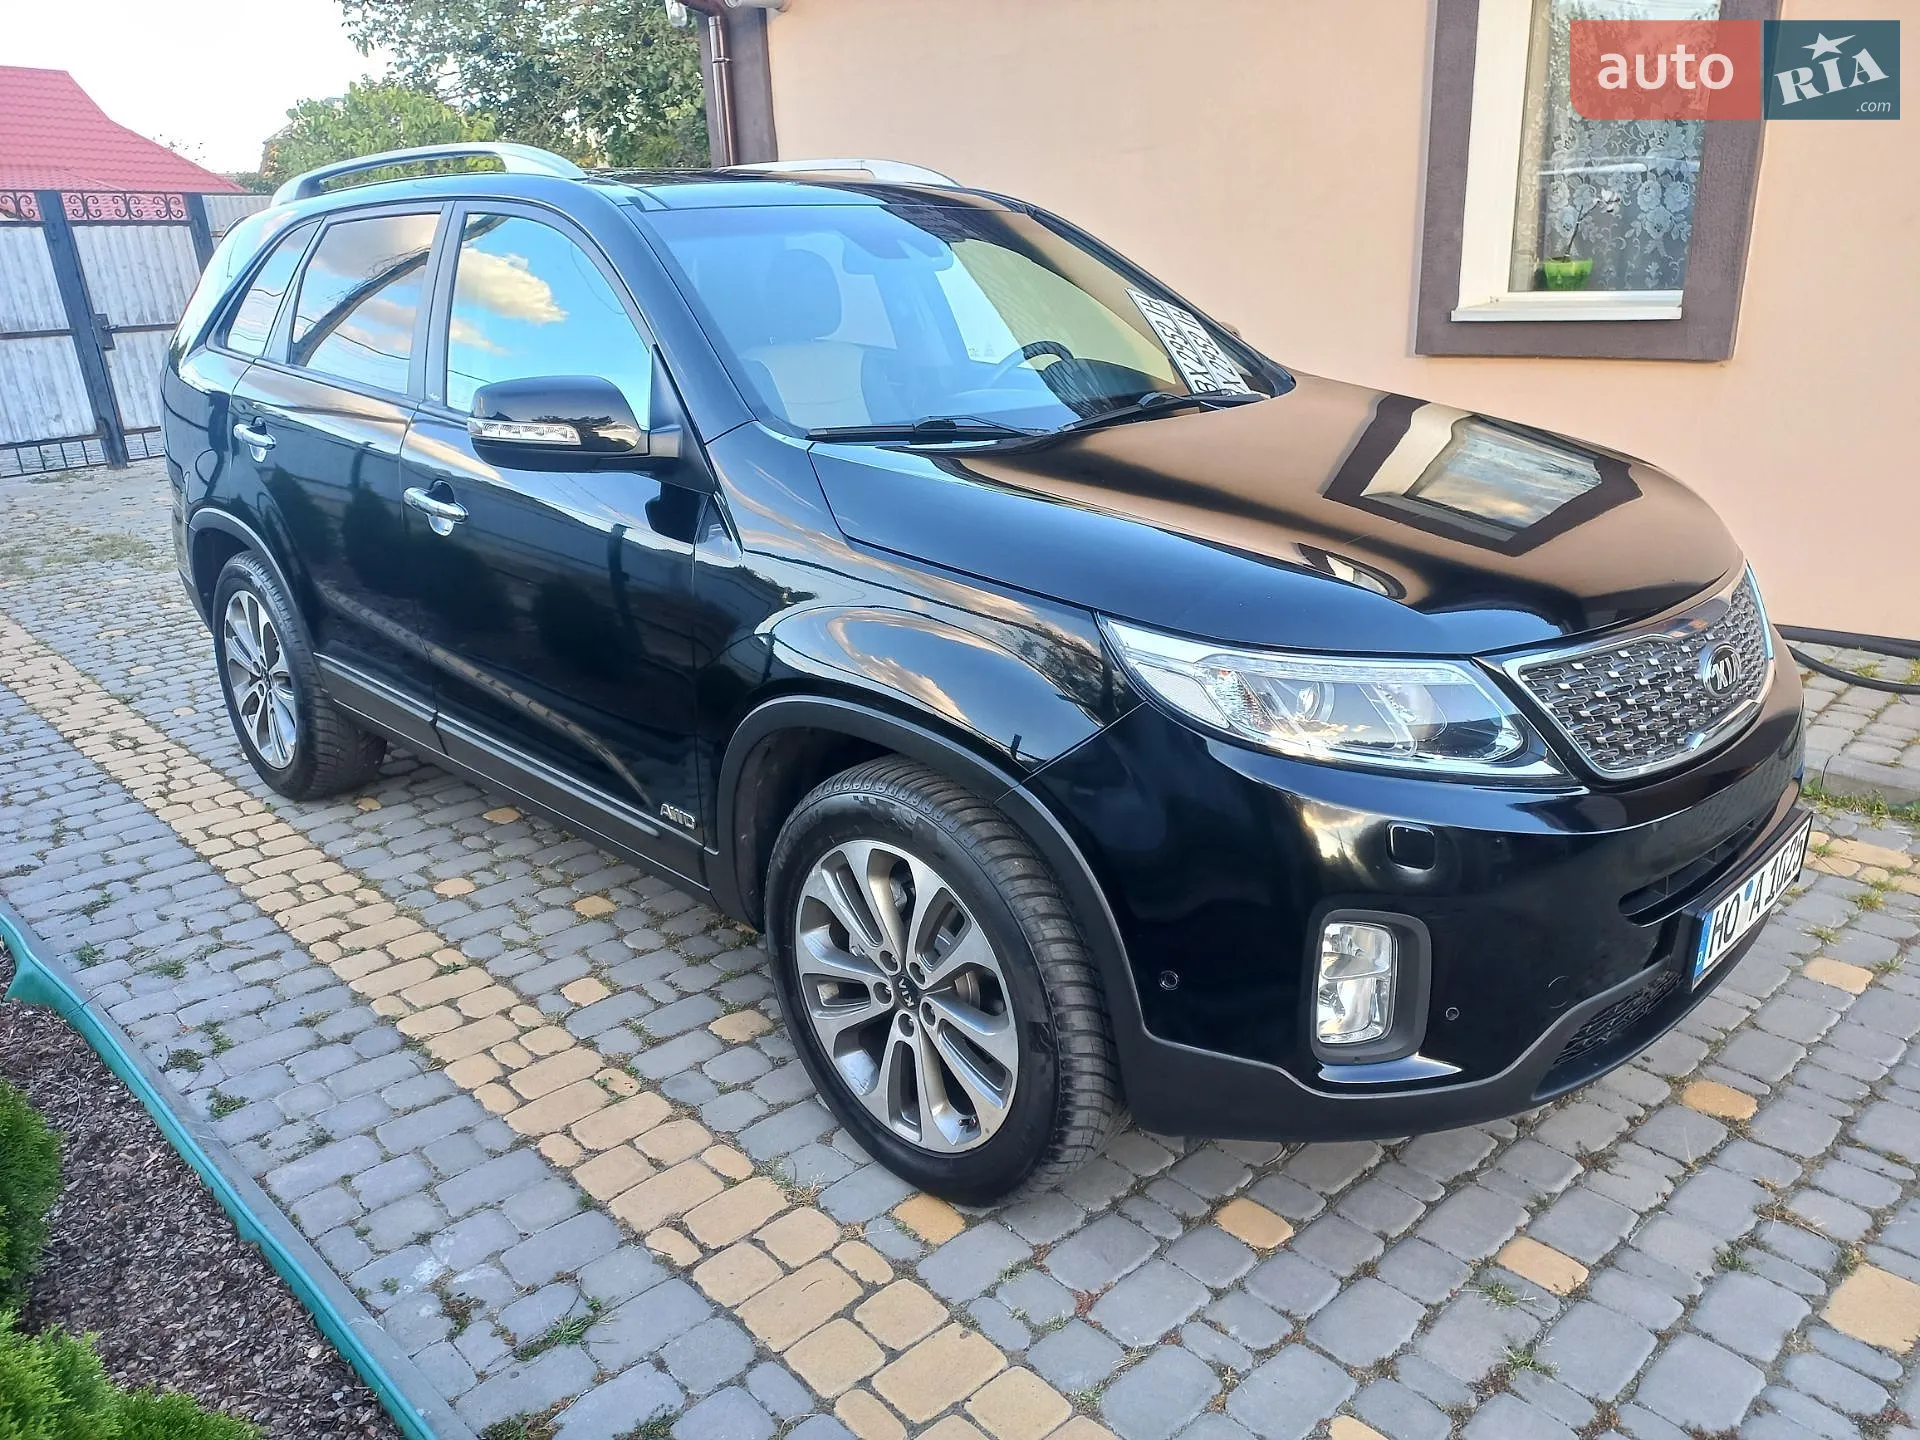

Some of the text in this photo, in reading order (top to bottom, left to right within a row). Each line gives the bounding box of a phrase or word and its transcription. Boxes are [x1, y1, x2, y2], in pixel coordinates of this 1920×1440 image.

[1709, 652, 1738, 690] KIA
[1708, 893, 1740, 959] HO
[898, 978, 915, 1007] KIA
